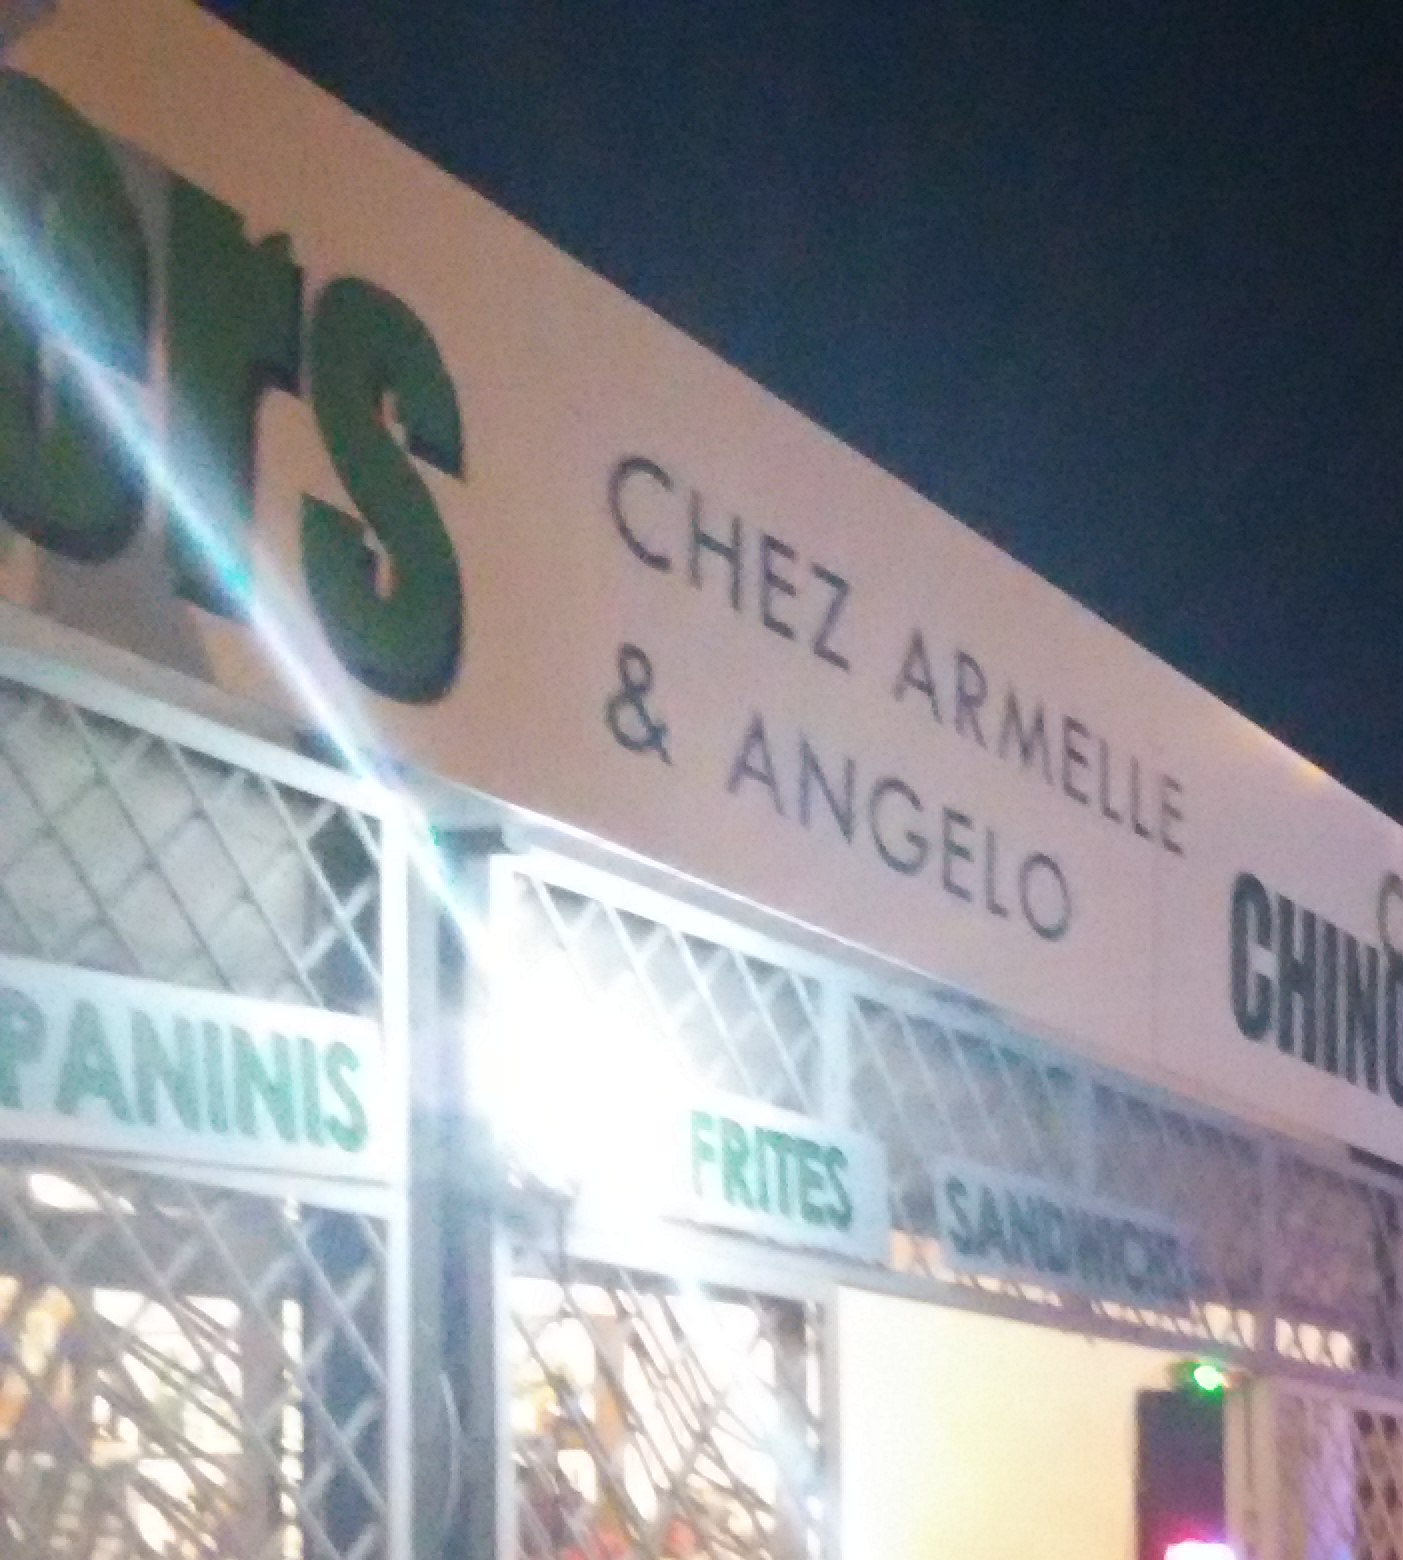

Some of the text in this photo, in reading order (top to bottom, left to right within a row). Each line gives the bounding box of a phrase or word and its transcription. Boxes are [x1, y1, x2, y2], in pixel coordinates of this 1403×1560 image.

[607, 453, 1186, 858] CHEZ ARMELLE
[603, 641, 1075, 942] & ANGELO
[0, 986, 369, 1153] PANINIS
[691, 1108, 855, 1234] FRITES
